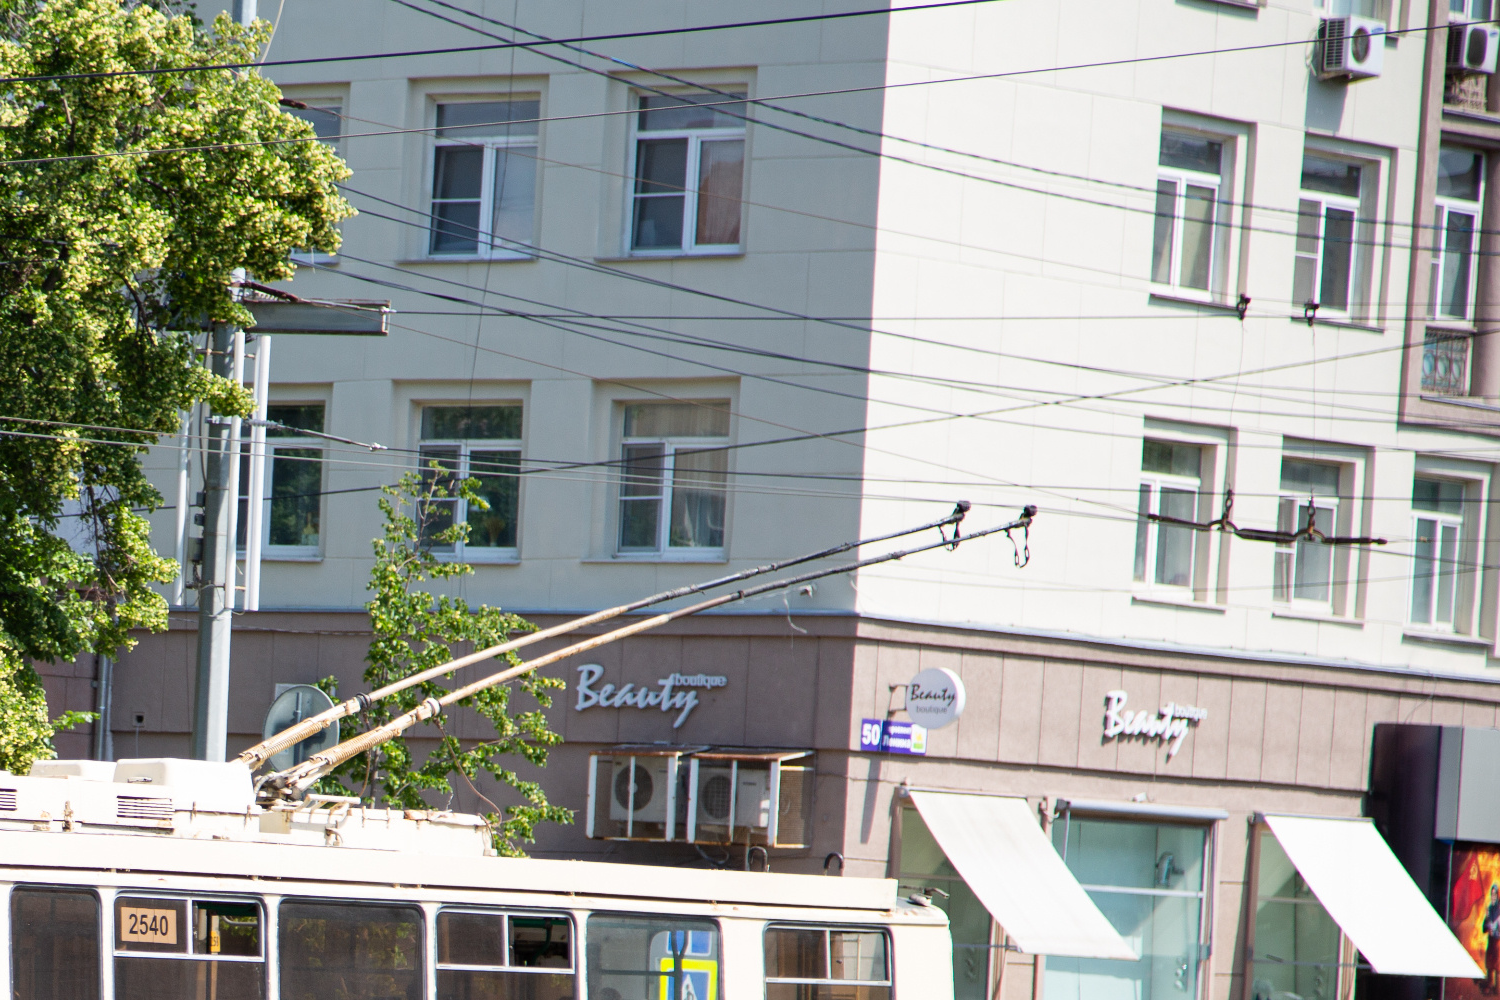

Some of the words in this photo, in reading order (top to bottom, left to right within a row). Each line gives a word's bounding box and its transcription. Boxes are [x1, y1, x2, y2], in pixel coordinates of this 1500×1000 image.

[674, 673, 727, 690] boutique
[575, 663, 699, 728] Beauty
[910, 684, 955, 707] Beauty
[916, 705, 948, 715] boutique
[861, 723, 881, 745] 50
[1103, 689, 1190, 757] Beauty
[128, 913, 169, 936] 2540
